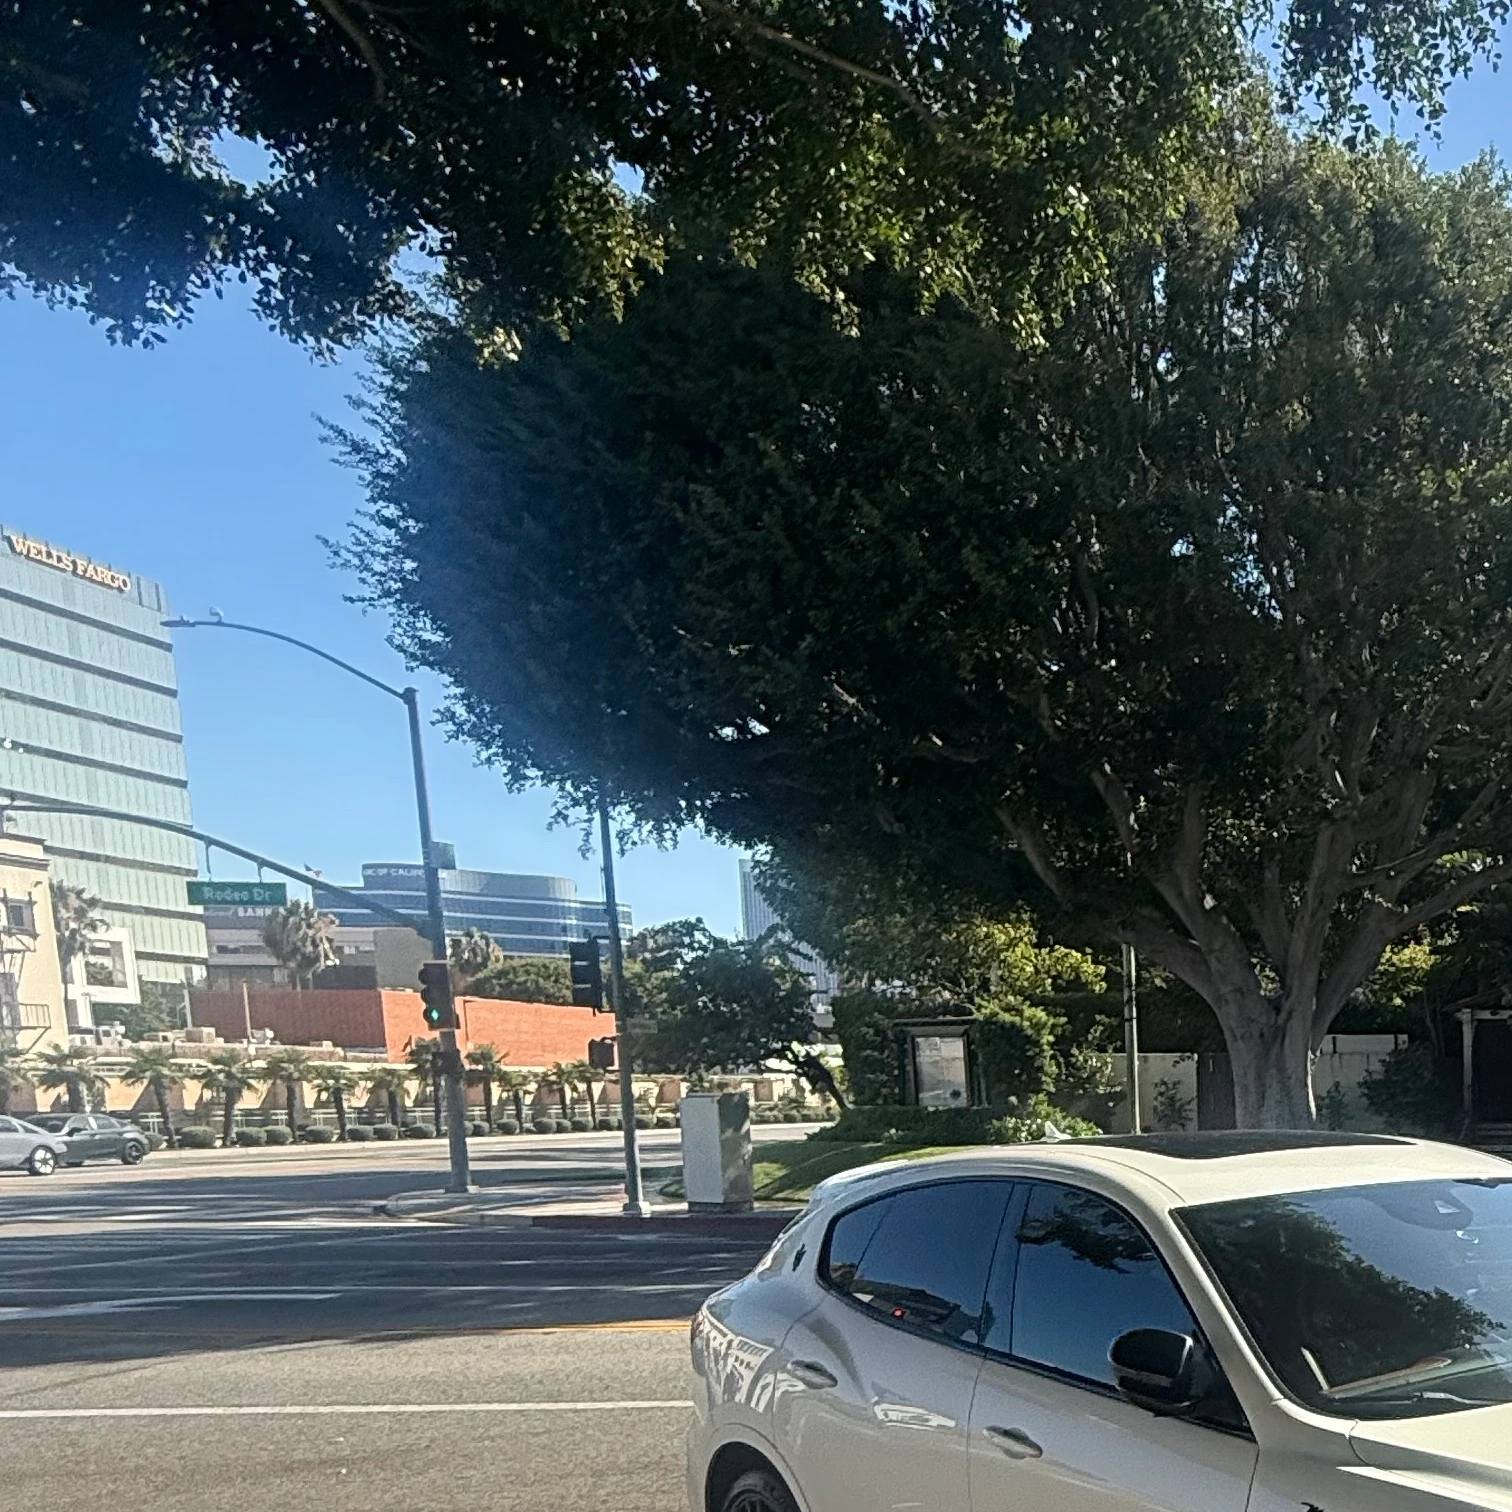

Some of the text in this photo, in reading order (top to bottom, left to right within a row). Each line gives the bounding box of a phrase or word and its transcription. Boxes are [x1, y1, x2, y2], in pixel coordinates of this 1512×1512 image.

[10, 535, 131, 592] WELLS FARGO
[203, 887, 272, 901] Rodeo Dr
[238, 906, 273, 917] BANK
